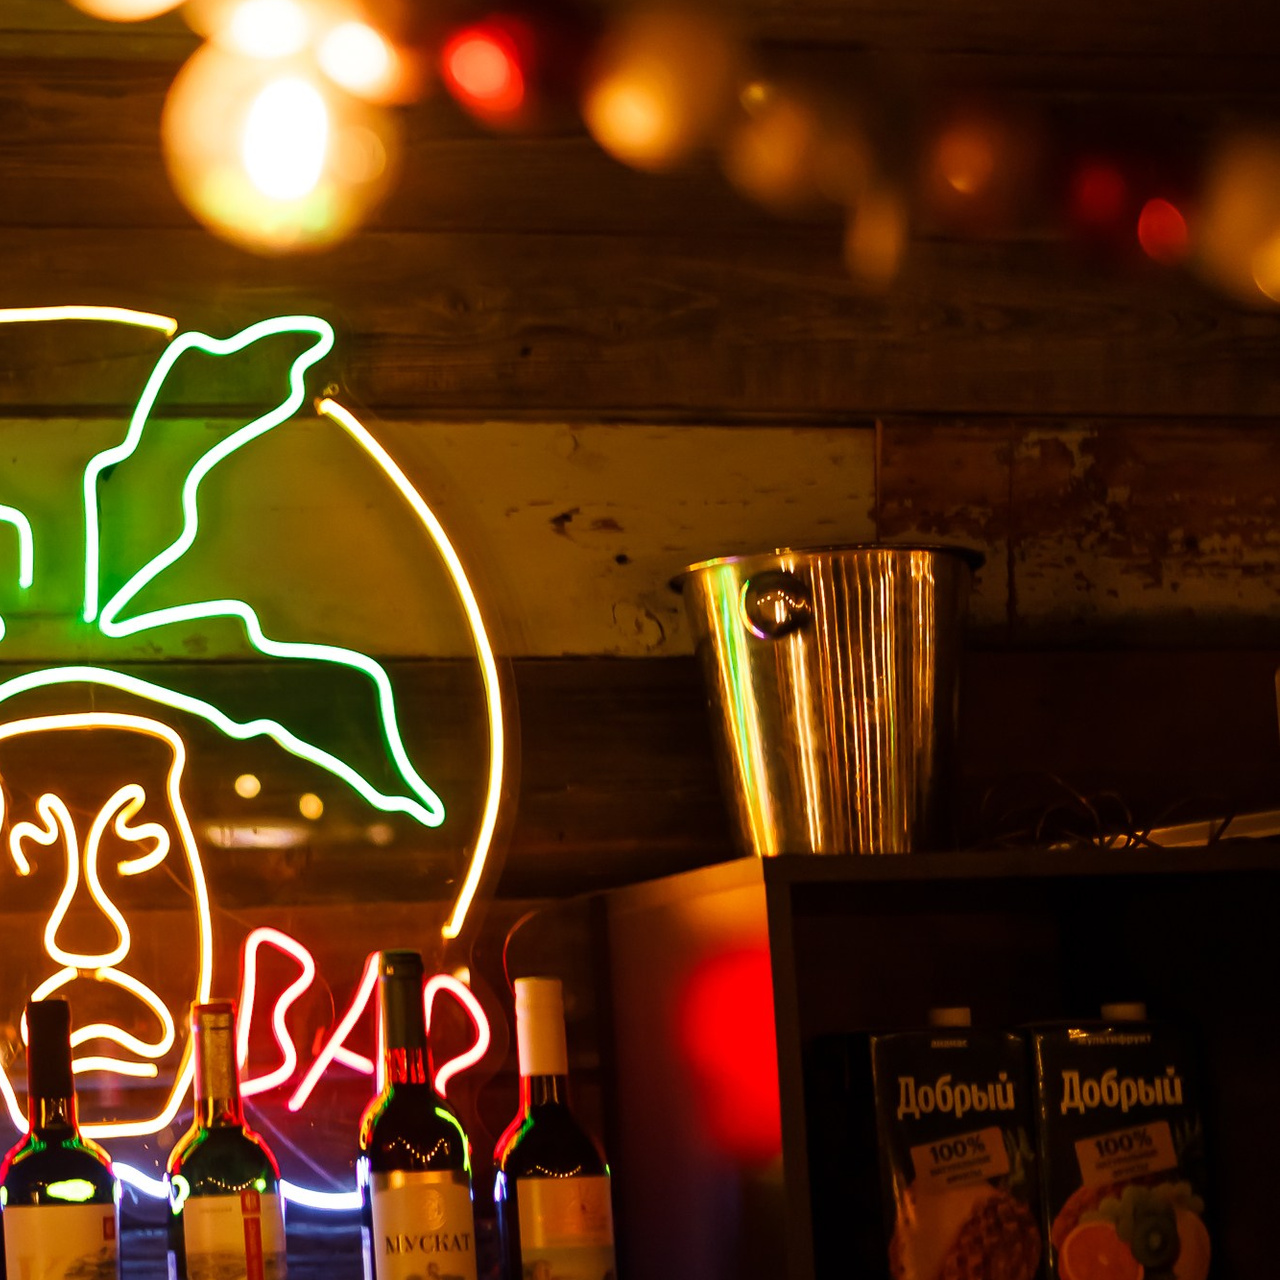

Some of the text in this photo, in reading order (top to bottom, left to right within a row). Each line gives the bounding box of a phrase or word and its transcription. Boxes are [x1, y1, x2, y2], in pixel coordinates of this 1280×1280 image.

[896, 1070, 1016, 1121] Добрый
[1060, 1065, 1184, 1116] Добрый
[930, 1133, 986, 1165] 100%
[1095, 1126, 1153, 1158] 100%
[384, 1232, 471, 1255] МУСКАТ
